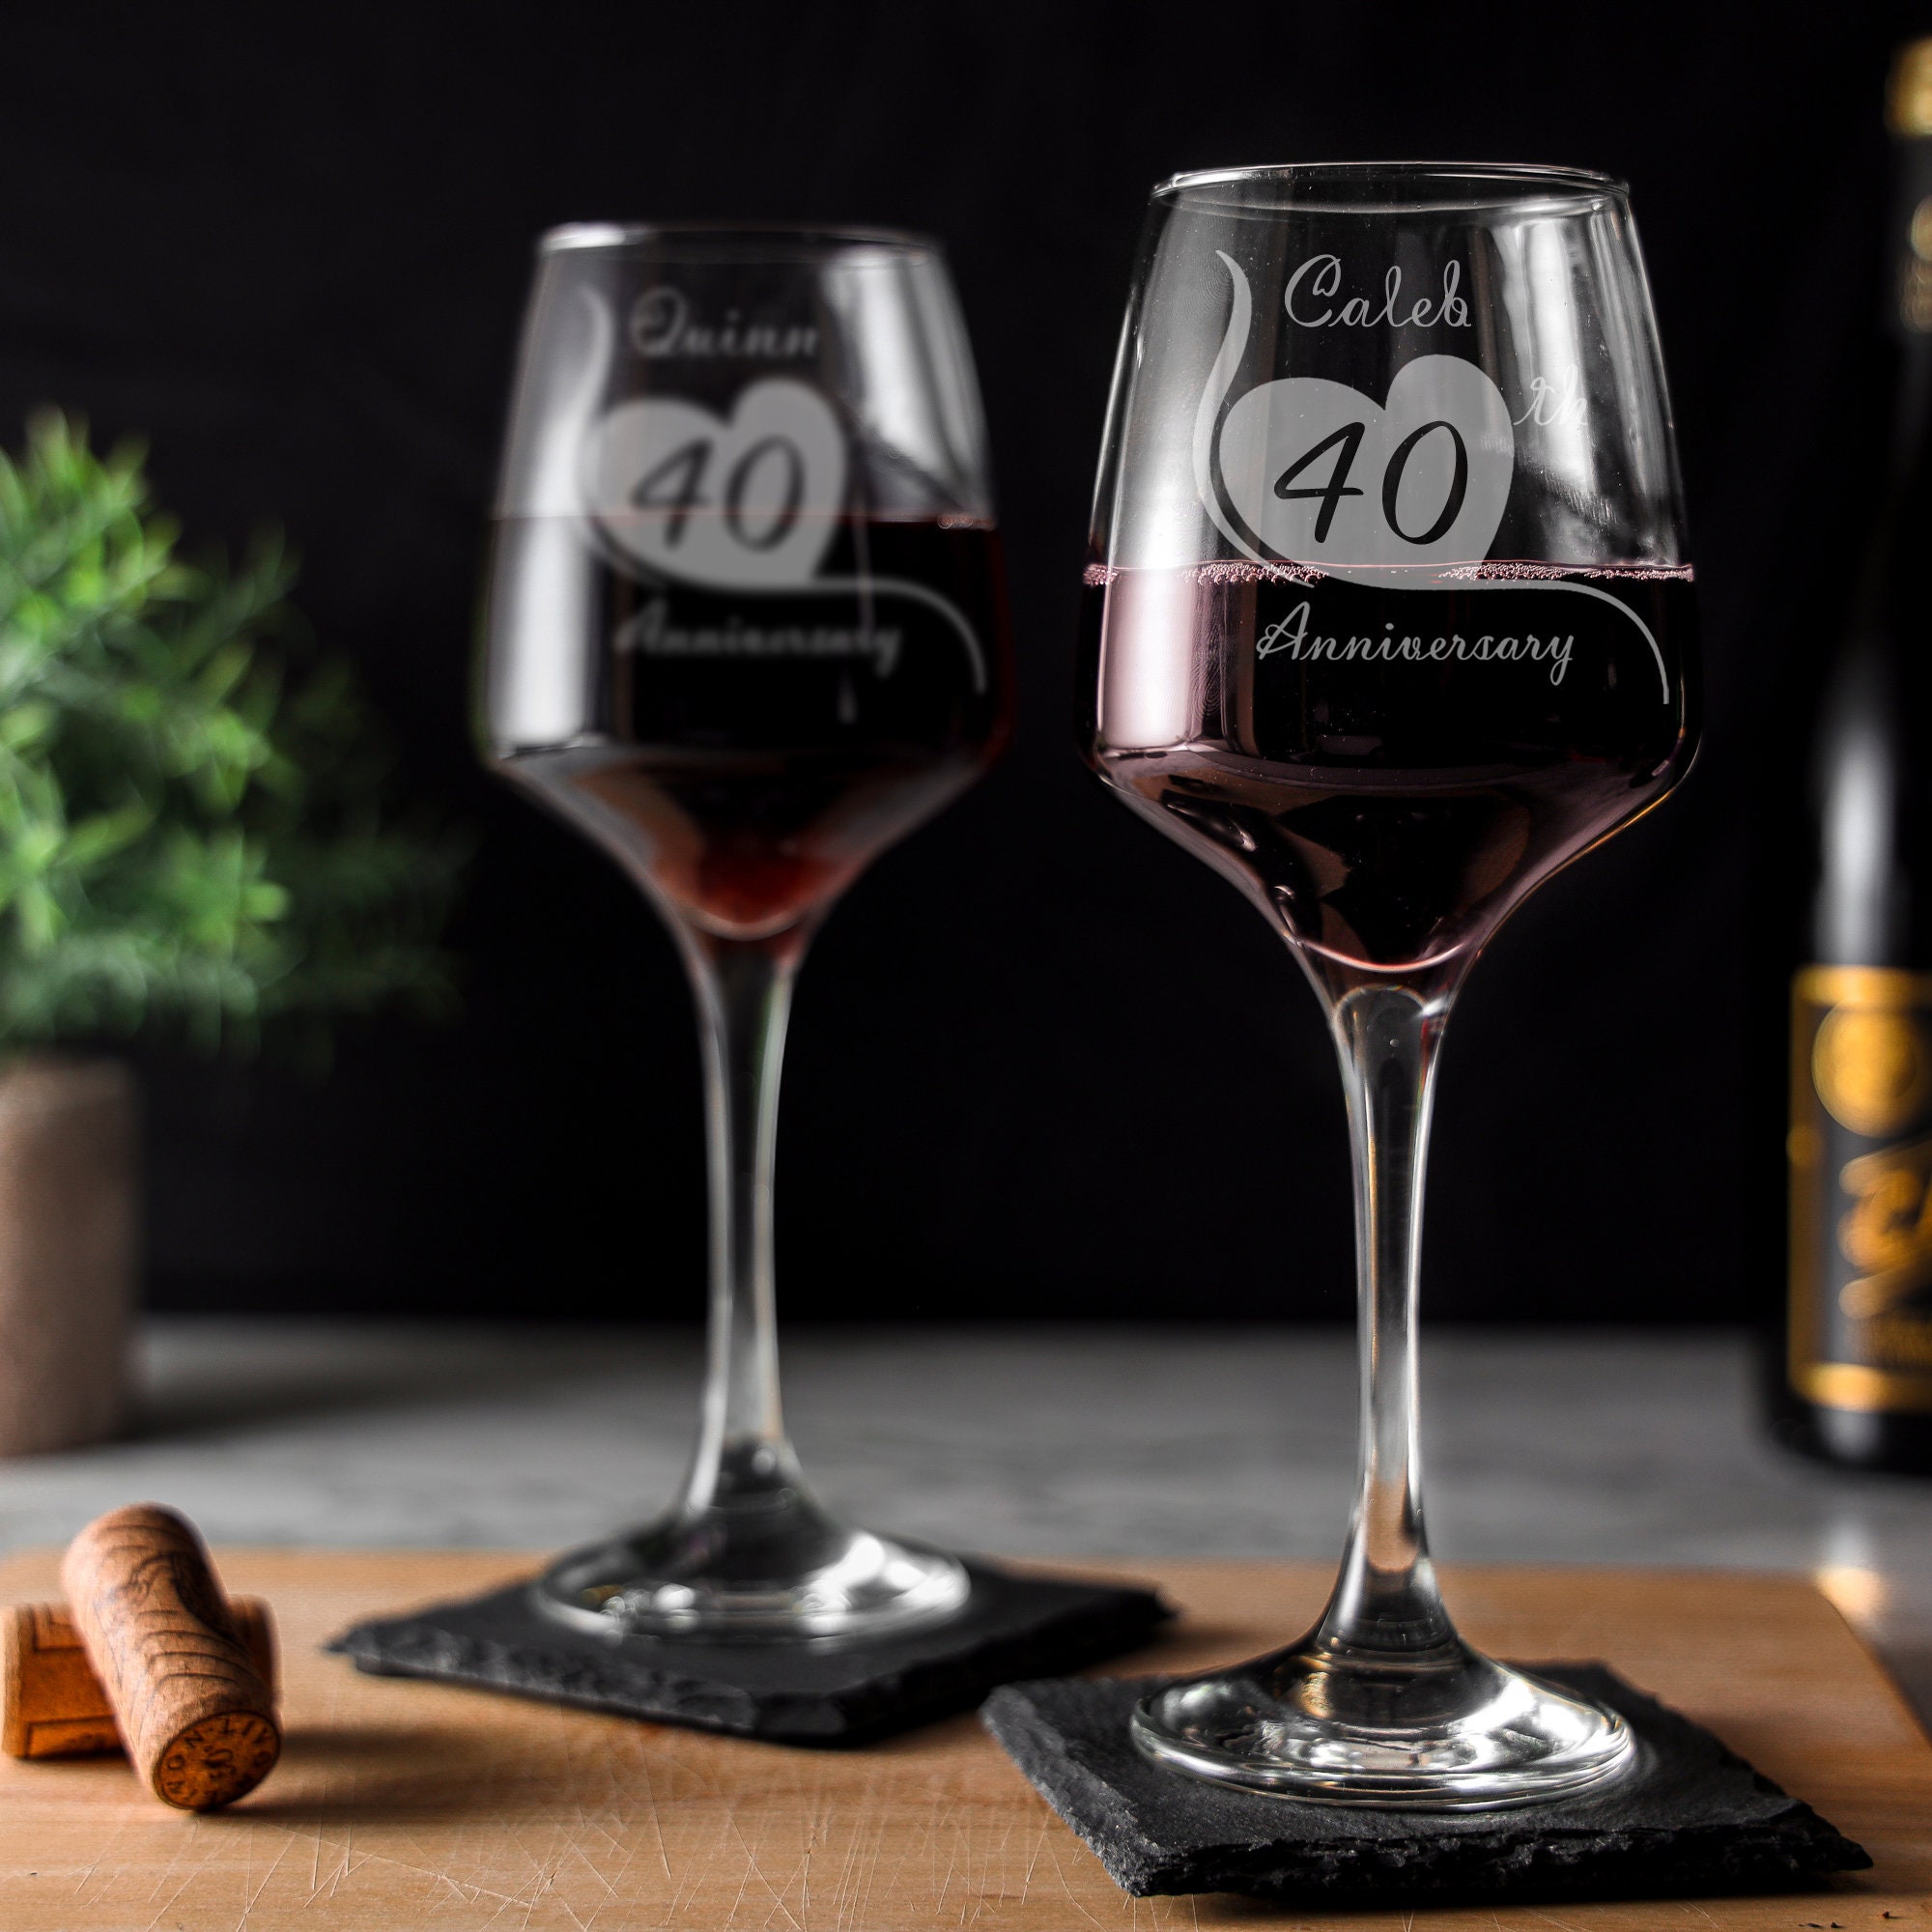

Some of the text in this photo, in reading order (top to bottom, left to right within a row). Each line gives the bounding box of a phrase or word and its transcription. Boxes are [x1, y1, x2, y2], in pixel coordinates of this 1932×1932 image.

[628, 286, 818, 357] Quinn
[1284, 253, 1472, 328] Caleb
[631, 433, 805, 553] 40
[1273, 419, 1469, 546] 40
[1255, 600, 1575, 686] Anniversary
